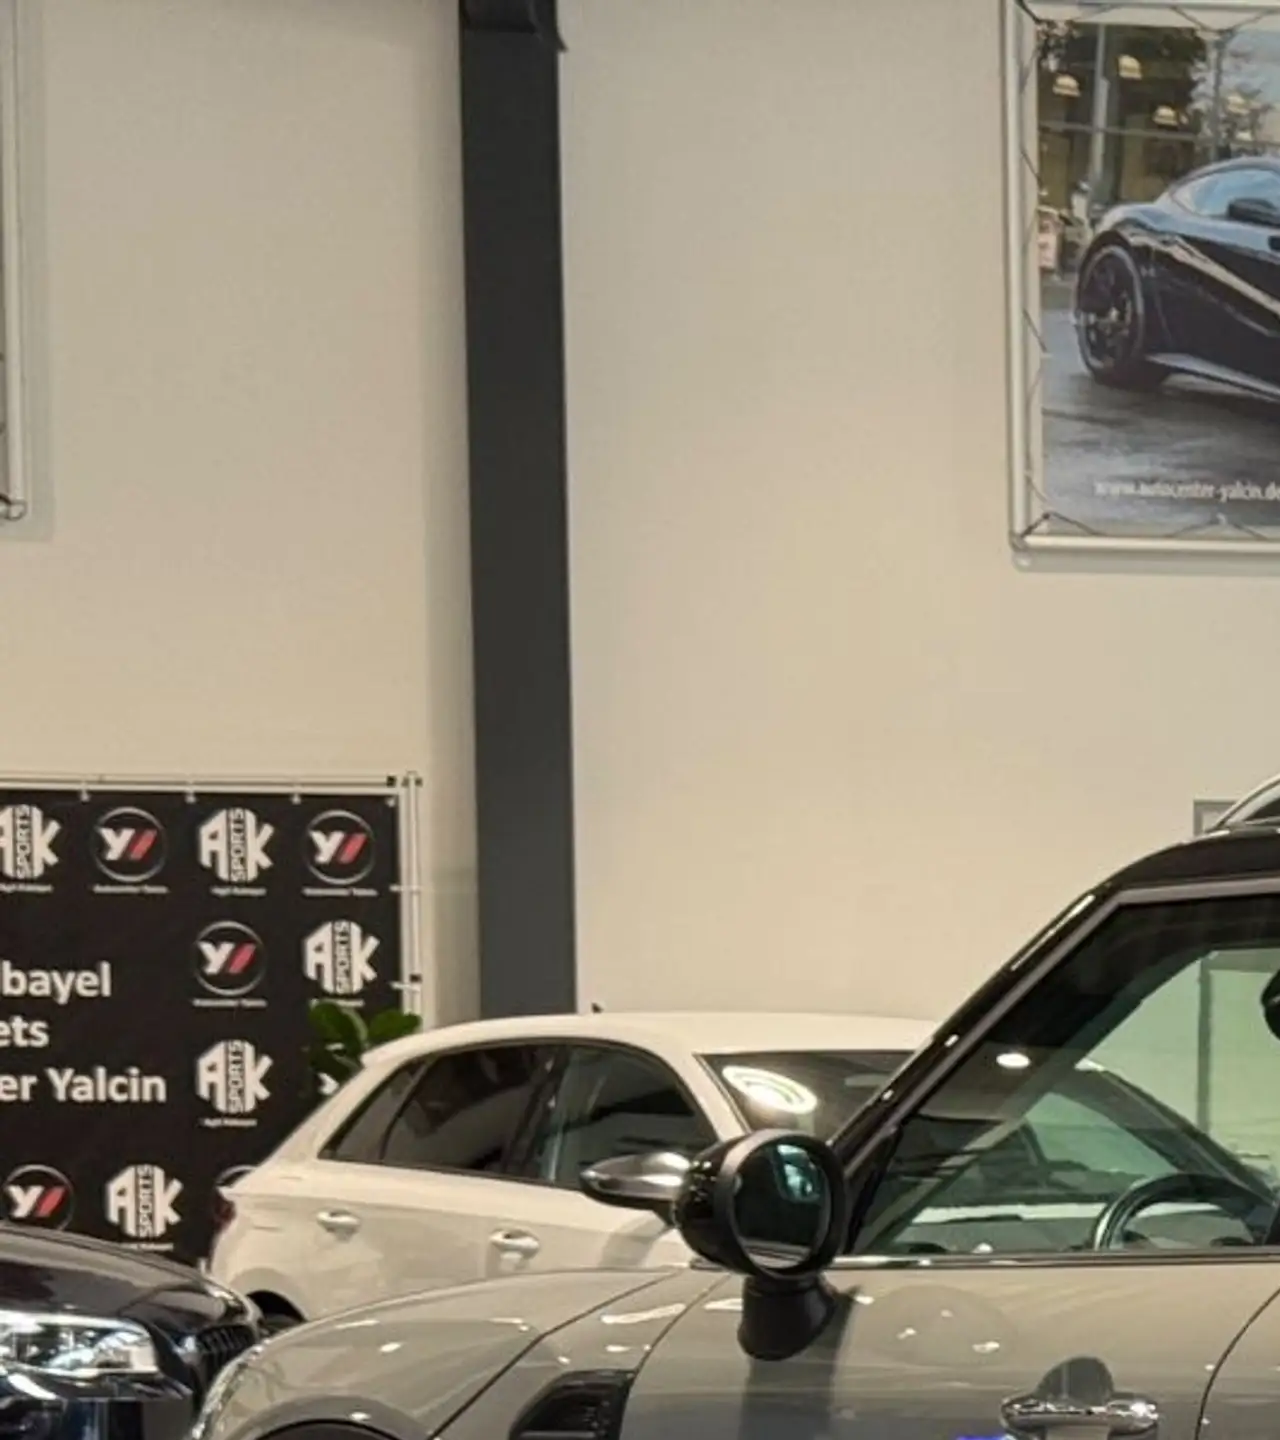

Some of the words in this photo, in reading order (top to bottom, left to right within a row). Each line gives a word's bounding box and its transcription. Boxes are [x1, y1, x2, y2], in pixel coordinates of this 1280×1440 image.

[229, 808, 246, 883] SPORTS
[2, 960, 112, 1005] bayel
[45, 1065, 167, 1102] Yalcin
